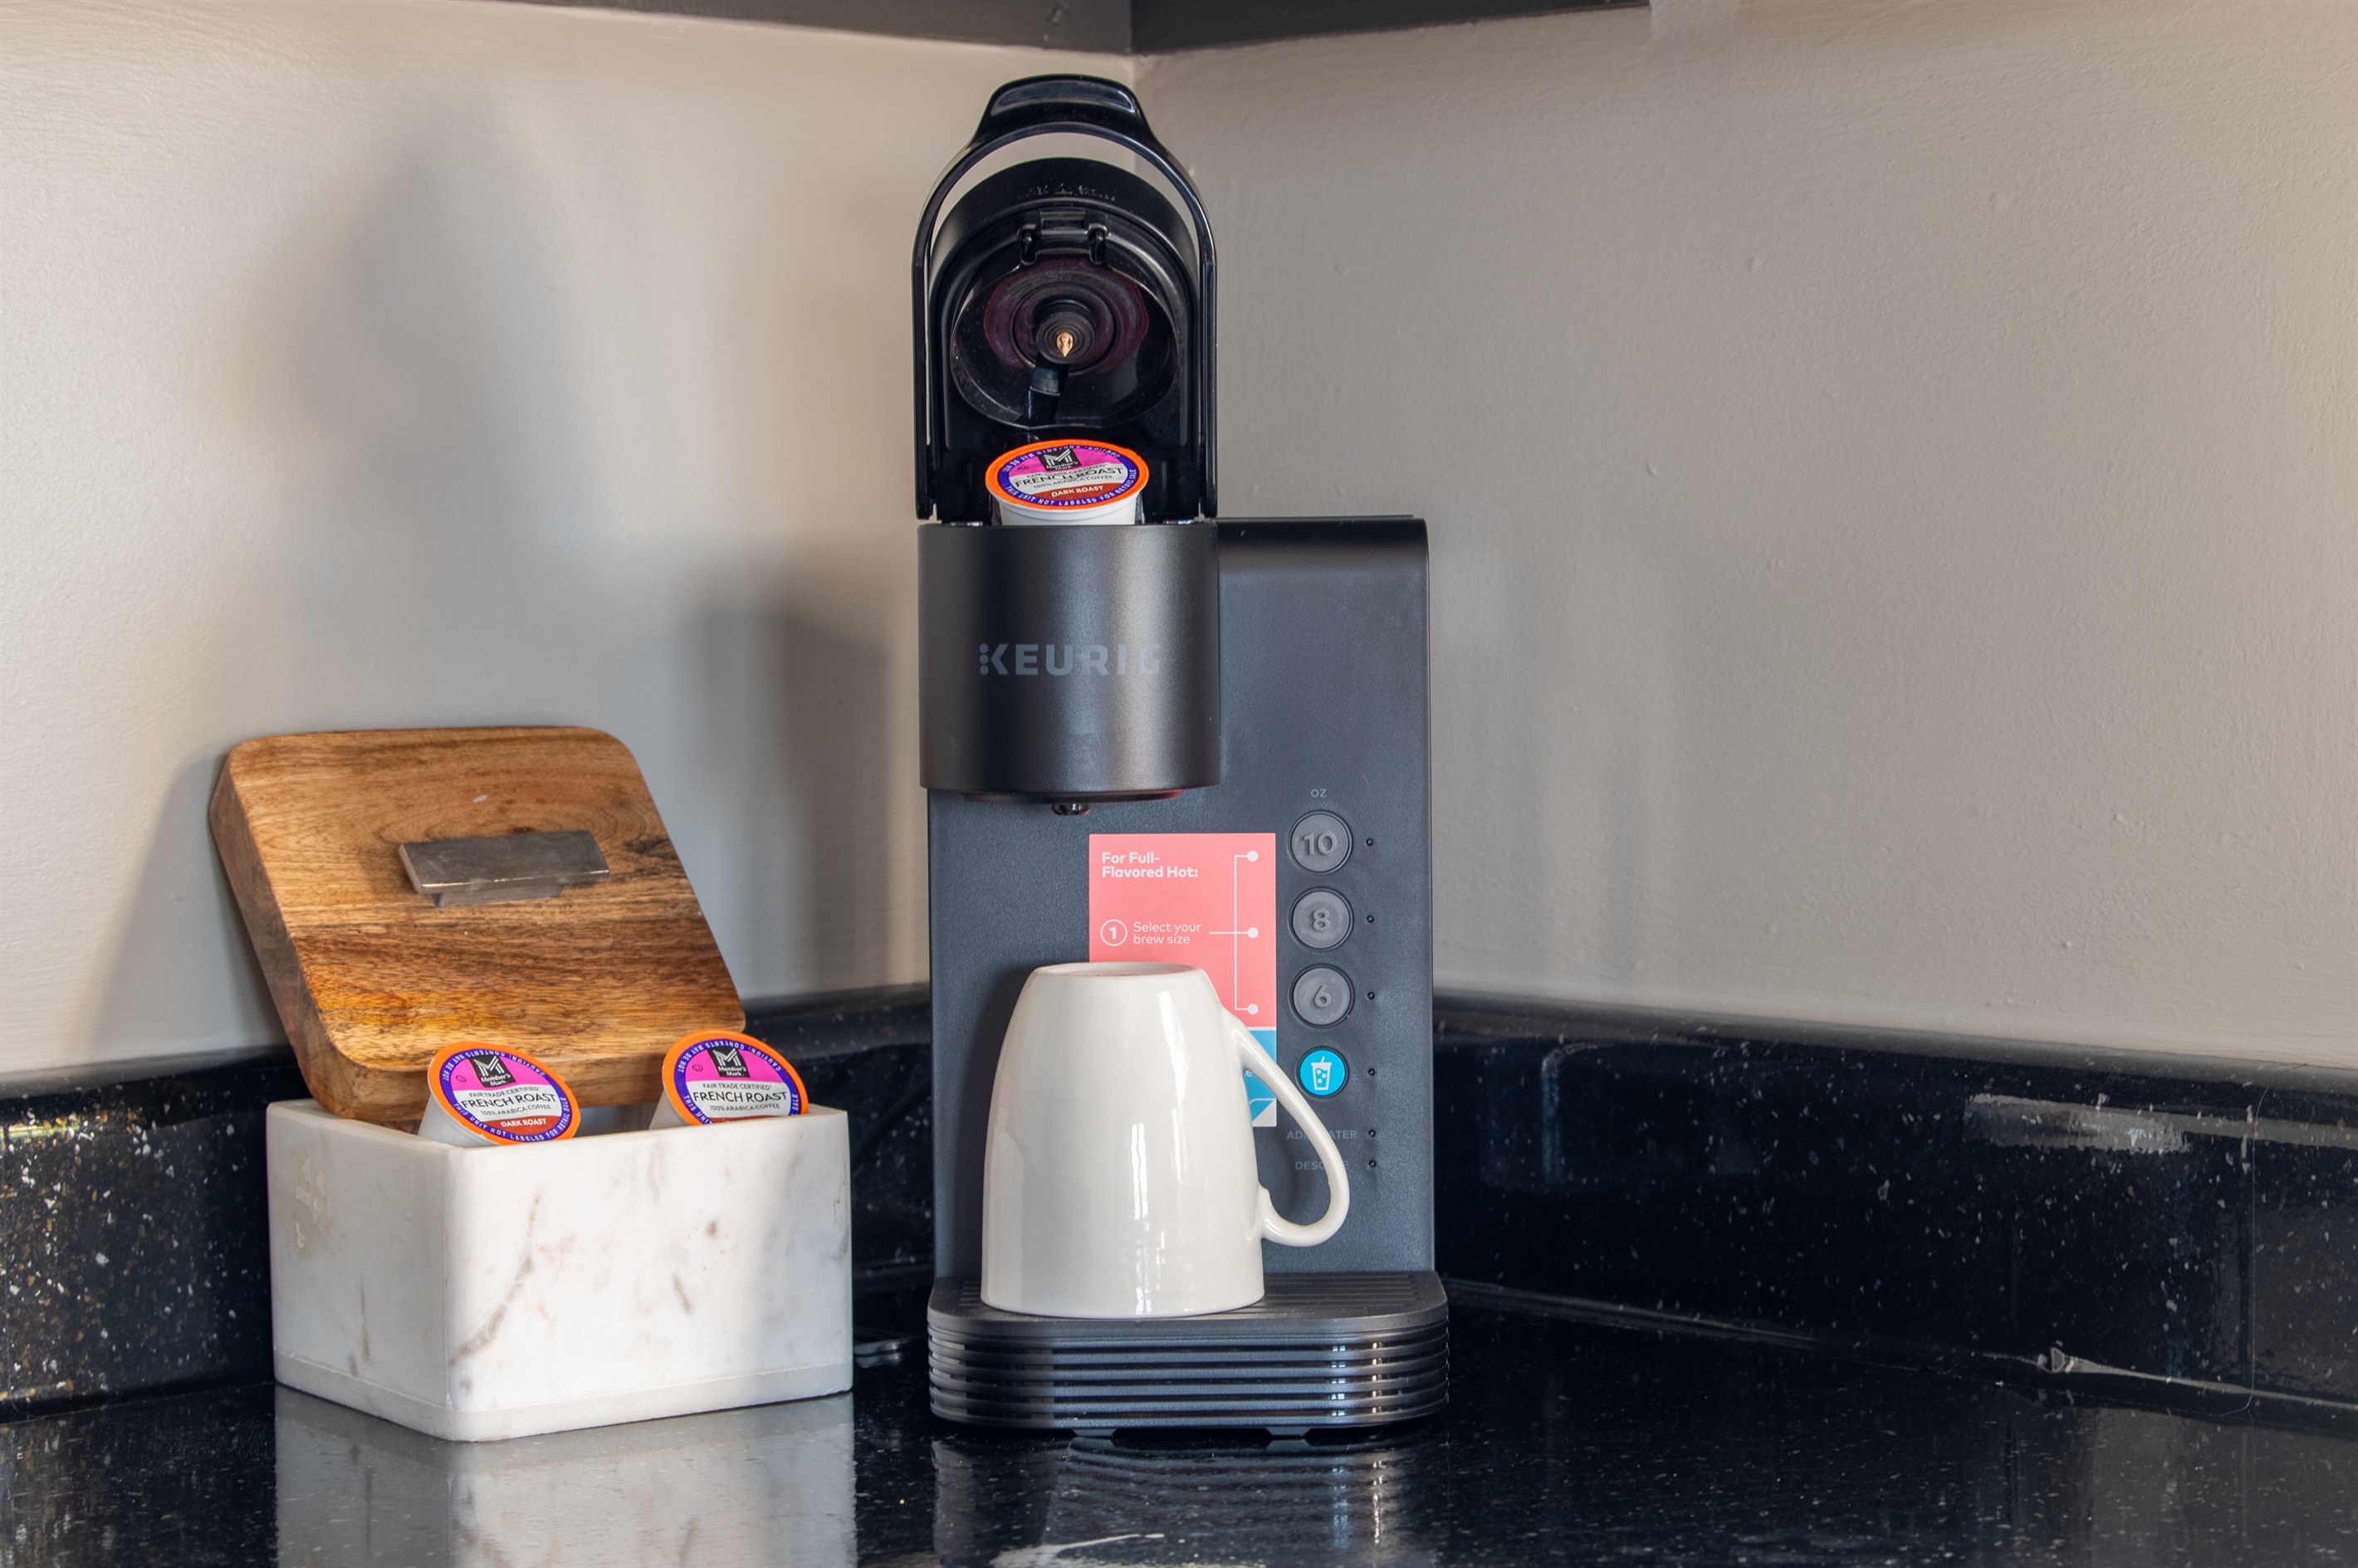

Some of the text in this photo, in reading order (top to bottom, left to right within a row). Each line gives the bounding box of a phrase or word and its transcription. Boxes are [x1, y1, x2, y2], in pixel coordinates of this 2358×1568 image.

[1015, 467, 1123, 488] FRENCH ROAST
[1053, 476, 1084, 486] ARABICA
[1005, 486, 1020, 496] THIS
[1019, 494, 1036, 502] UNIT
[1059, 498, 1098, 506] LABELED
[1099, 491, 1115, 501] FOR
[1051, 485, 1103, 497] DARK ROAST
[979, 643, 1160, 677] KEURIG
[1303, 832, 1337, 856] 10
[1102, 851, 1160, 864] For Full-
[1102, 866, 1199, 878] Flavored Hot:
[1312, 908, 1330, 931] 8
[1108, 926, 1117, 940] 1
[1133, 921, 1201, 936] Select your
[1133, 933, 1191, 945] brew size
[1314, 985, 1332, 1008] 6
[691, 1044, 704, 1054] MAY
[682, 1053, 692, 1061] BE
[481, 1073, 511, 1082] Member's
[461, 1092, 556, 1109] FRENCH ROAST
[683, 1095, 697, 1111] THIS
[693, 1091, 787, 1102] FRENCH ROAST
[791, 1093, 800, 1111] SALE
[453, 1103, 468, 1116] THIS
[498, 1106, 527, 1115] ARABICA
[560, 1097, 570, 1111] SALE
[469, 1116, 487, 1129] UNIT
[557, 1113, 570, 1131] RETAIL
[490, 1127, 506, 1137] NOT
[545, 1128, 558, 1138] FOR
[1295, 1160, 1349, 1170] DESCE
